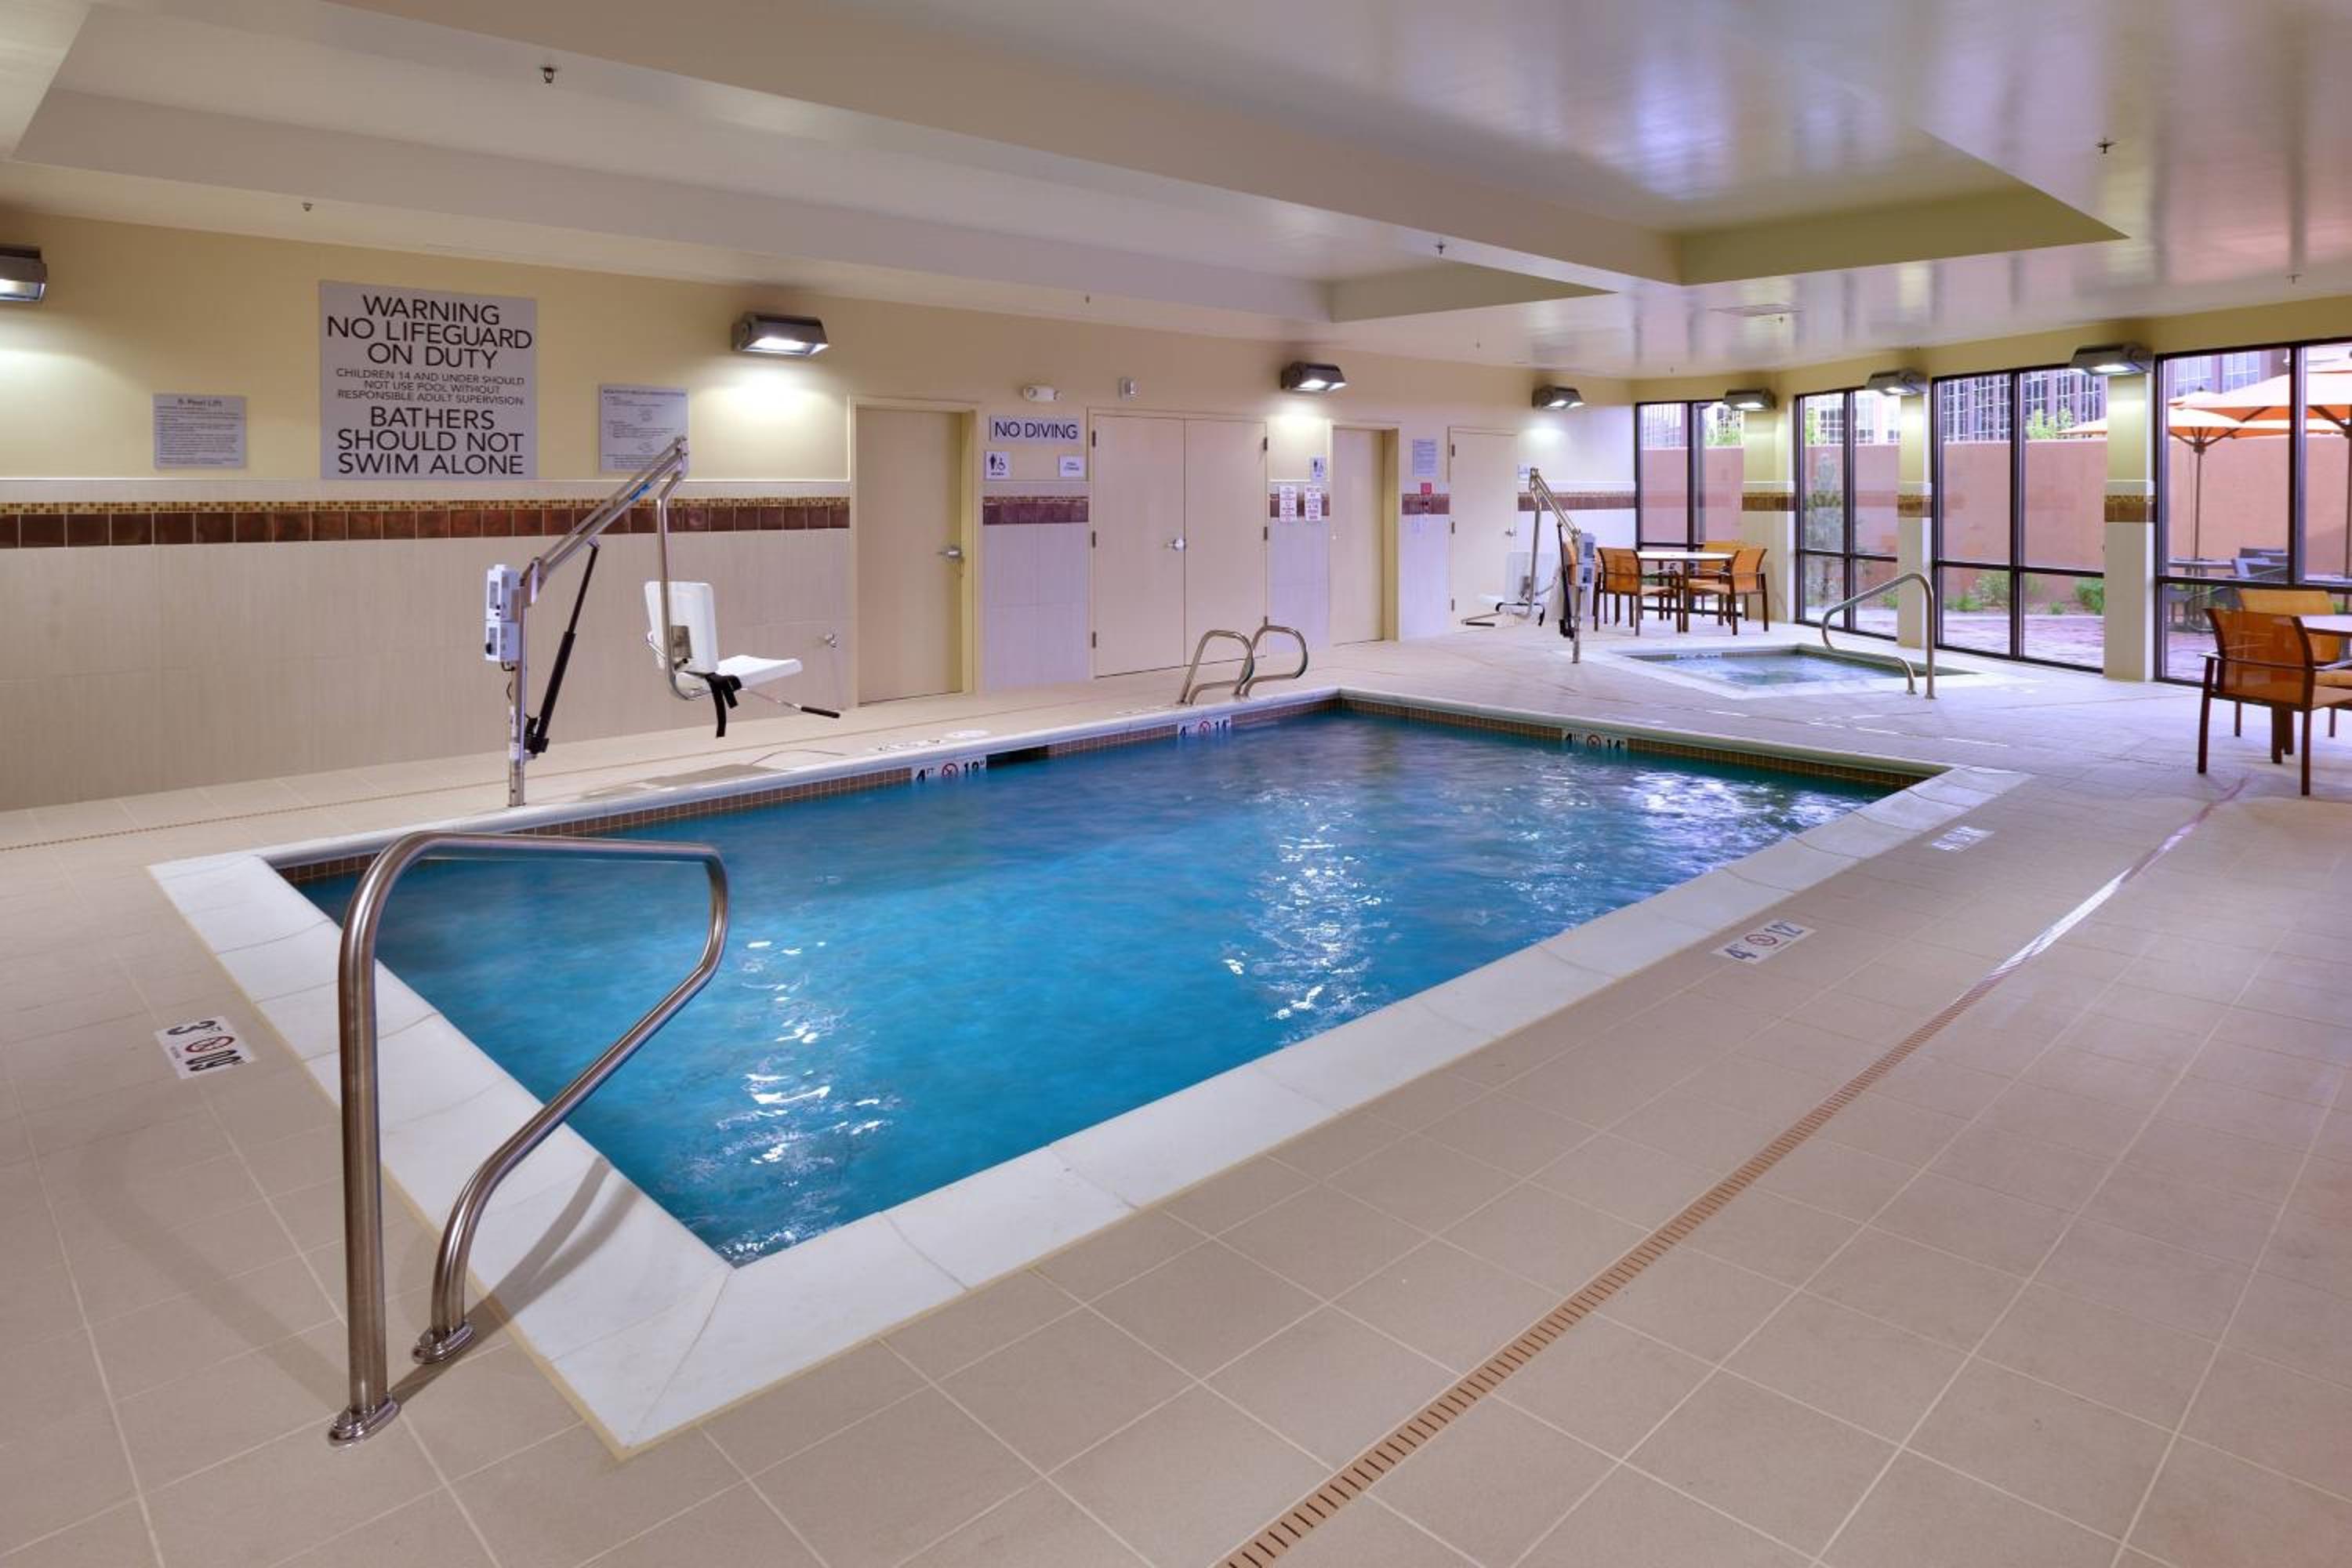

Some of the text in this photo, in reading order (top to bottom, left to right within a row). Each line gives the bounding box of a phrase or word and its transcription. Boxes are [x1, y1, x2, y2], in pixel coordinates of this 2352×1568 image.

[363, 295, 499, 325] WARNING
[328, 316, 532, 349] NO LIFEGUARD
[368, 343, 498, 368] ON DUTY
[336, 368, 524, 385] CHILDREN 14 AND UNDER SHOULD
[364, 380, 500, 394] NOT USE POOL WITHOUT
[338, 389, 524, 405] RESPONSIBLE ADULT SUPERVISION
[371, 406, 495, 430] BATHERS
[338, 429, 524, 452] SHOULD NOT
[995, 422, 1078, 440] NO DIVING
[338, 452, 524, 474] SWIM ALONE
